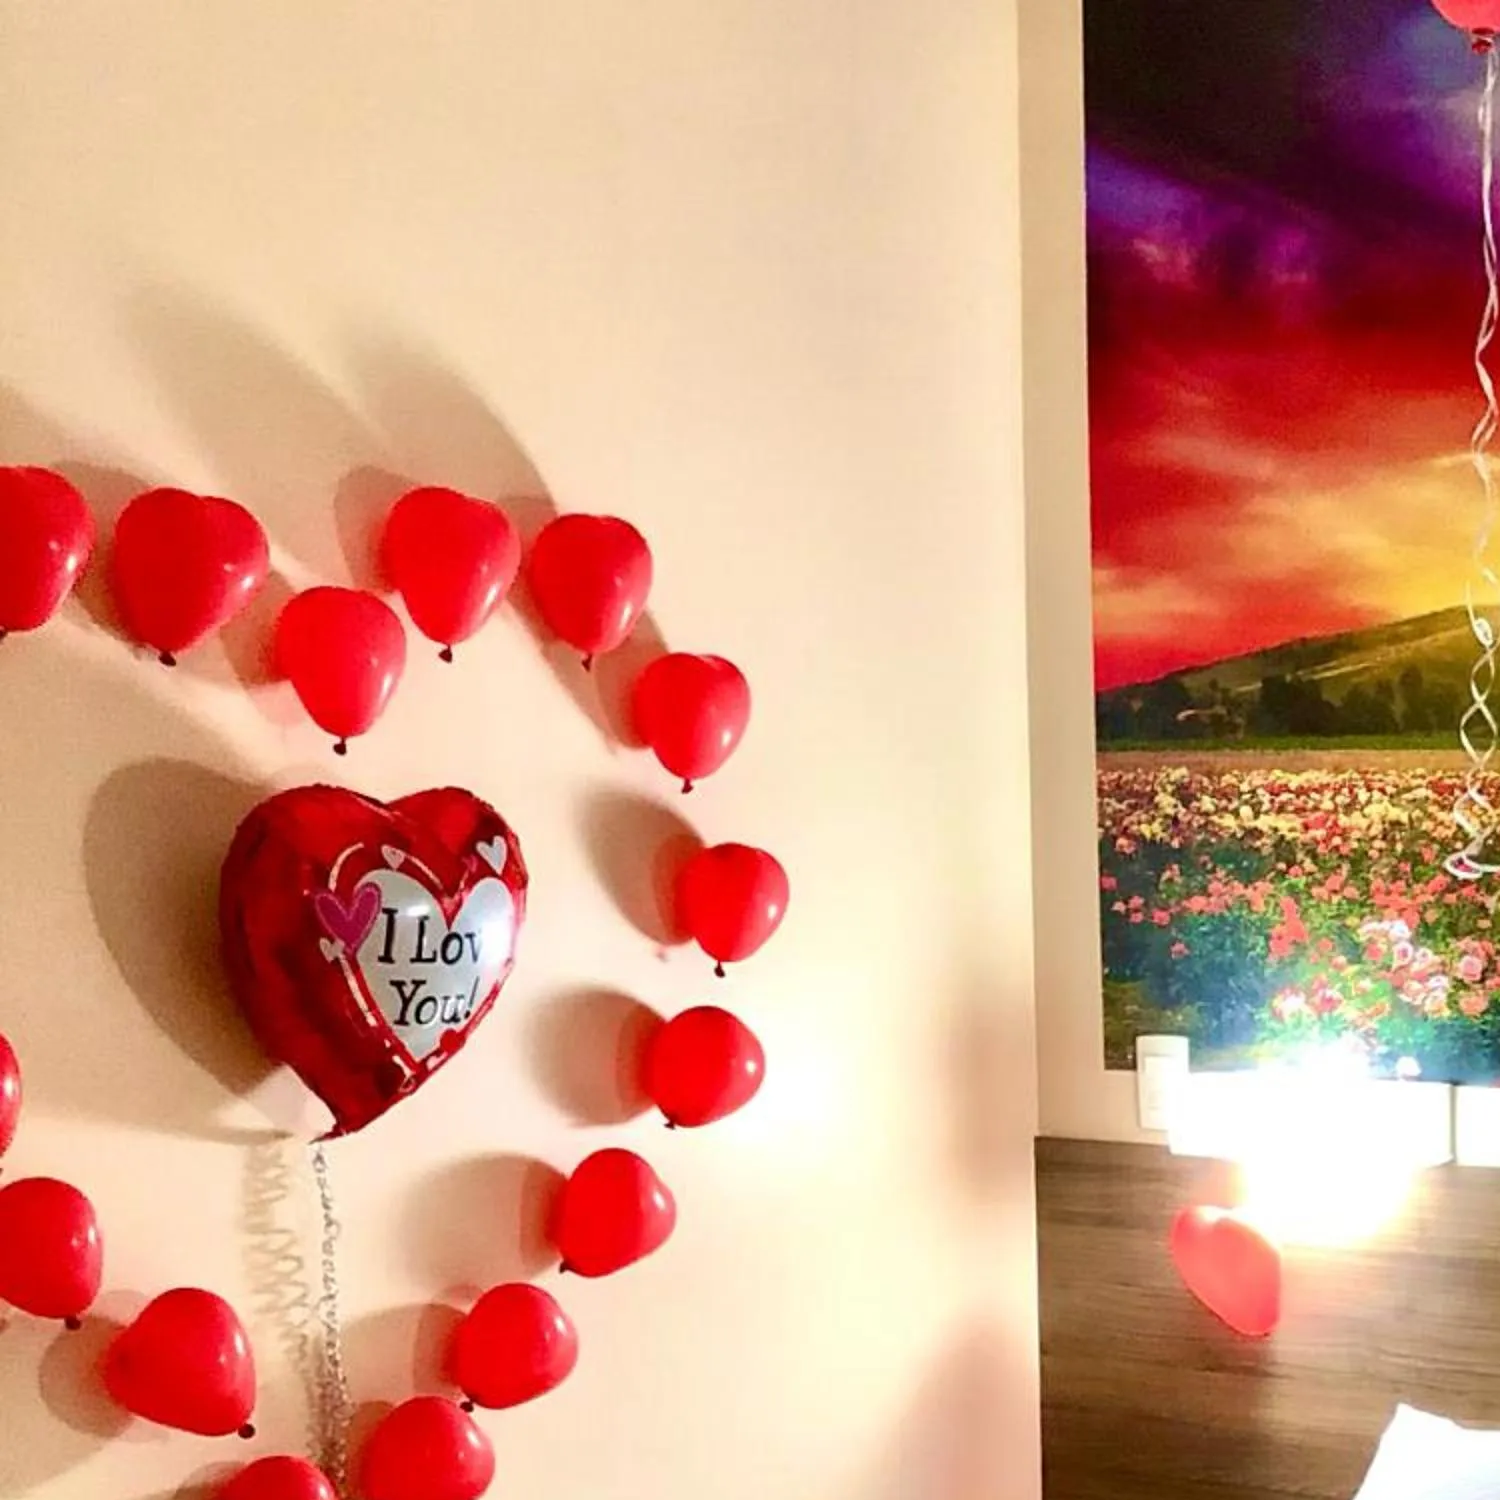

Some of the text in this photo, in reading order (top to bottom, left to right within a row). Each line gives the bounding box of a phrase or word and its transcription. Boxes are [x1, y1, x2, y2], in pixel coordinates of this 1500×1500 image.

[376, 907, 486, 965] I Lov
[389, 975, 481, 1027] You!
